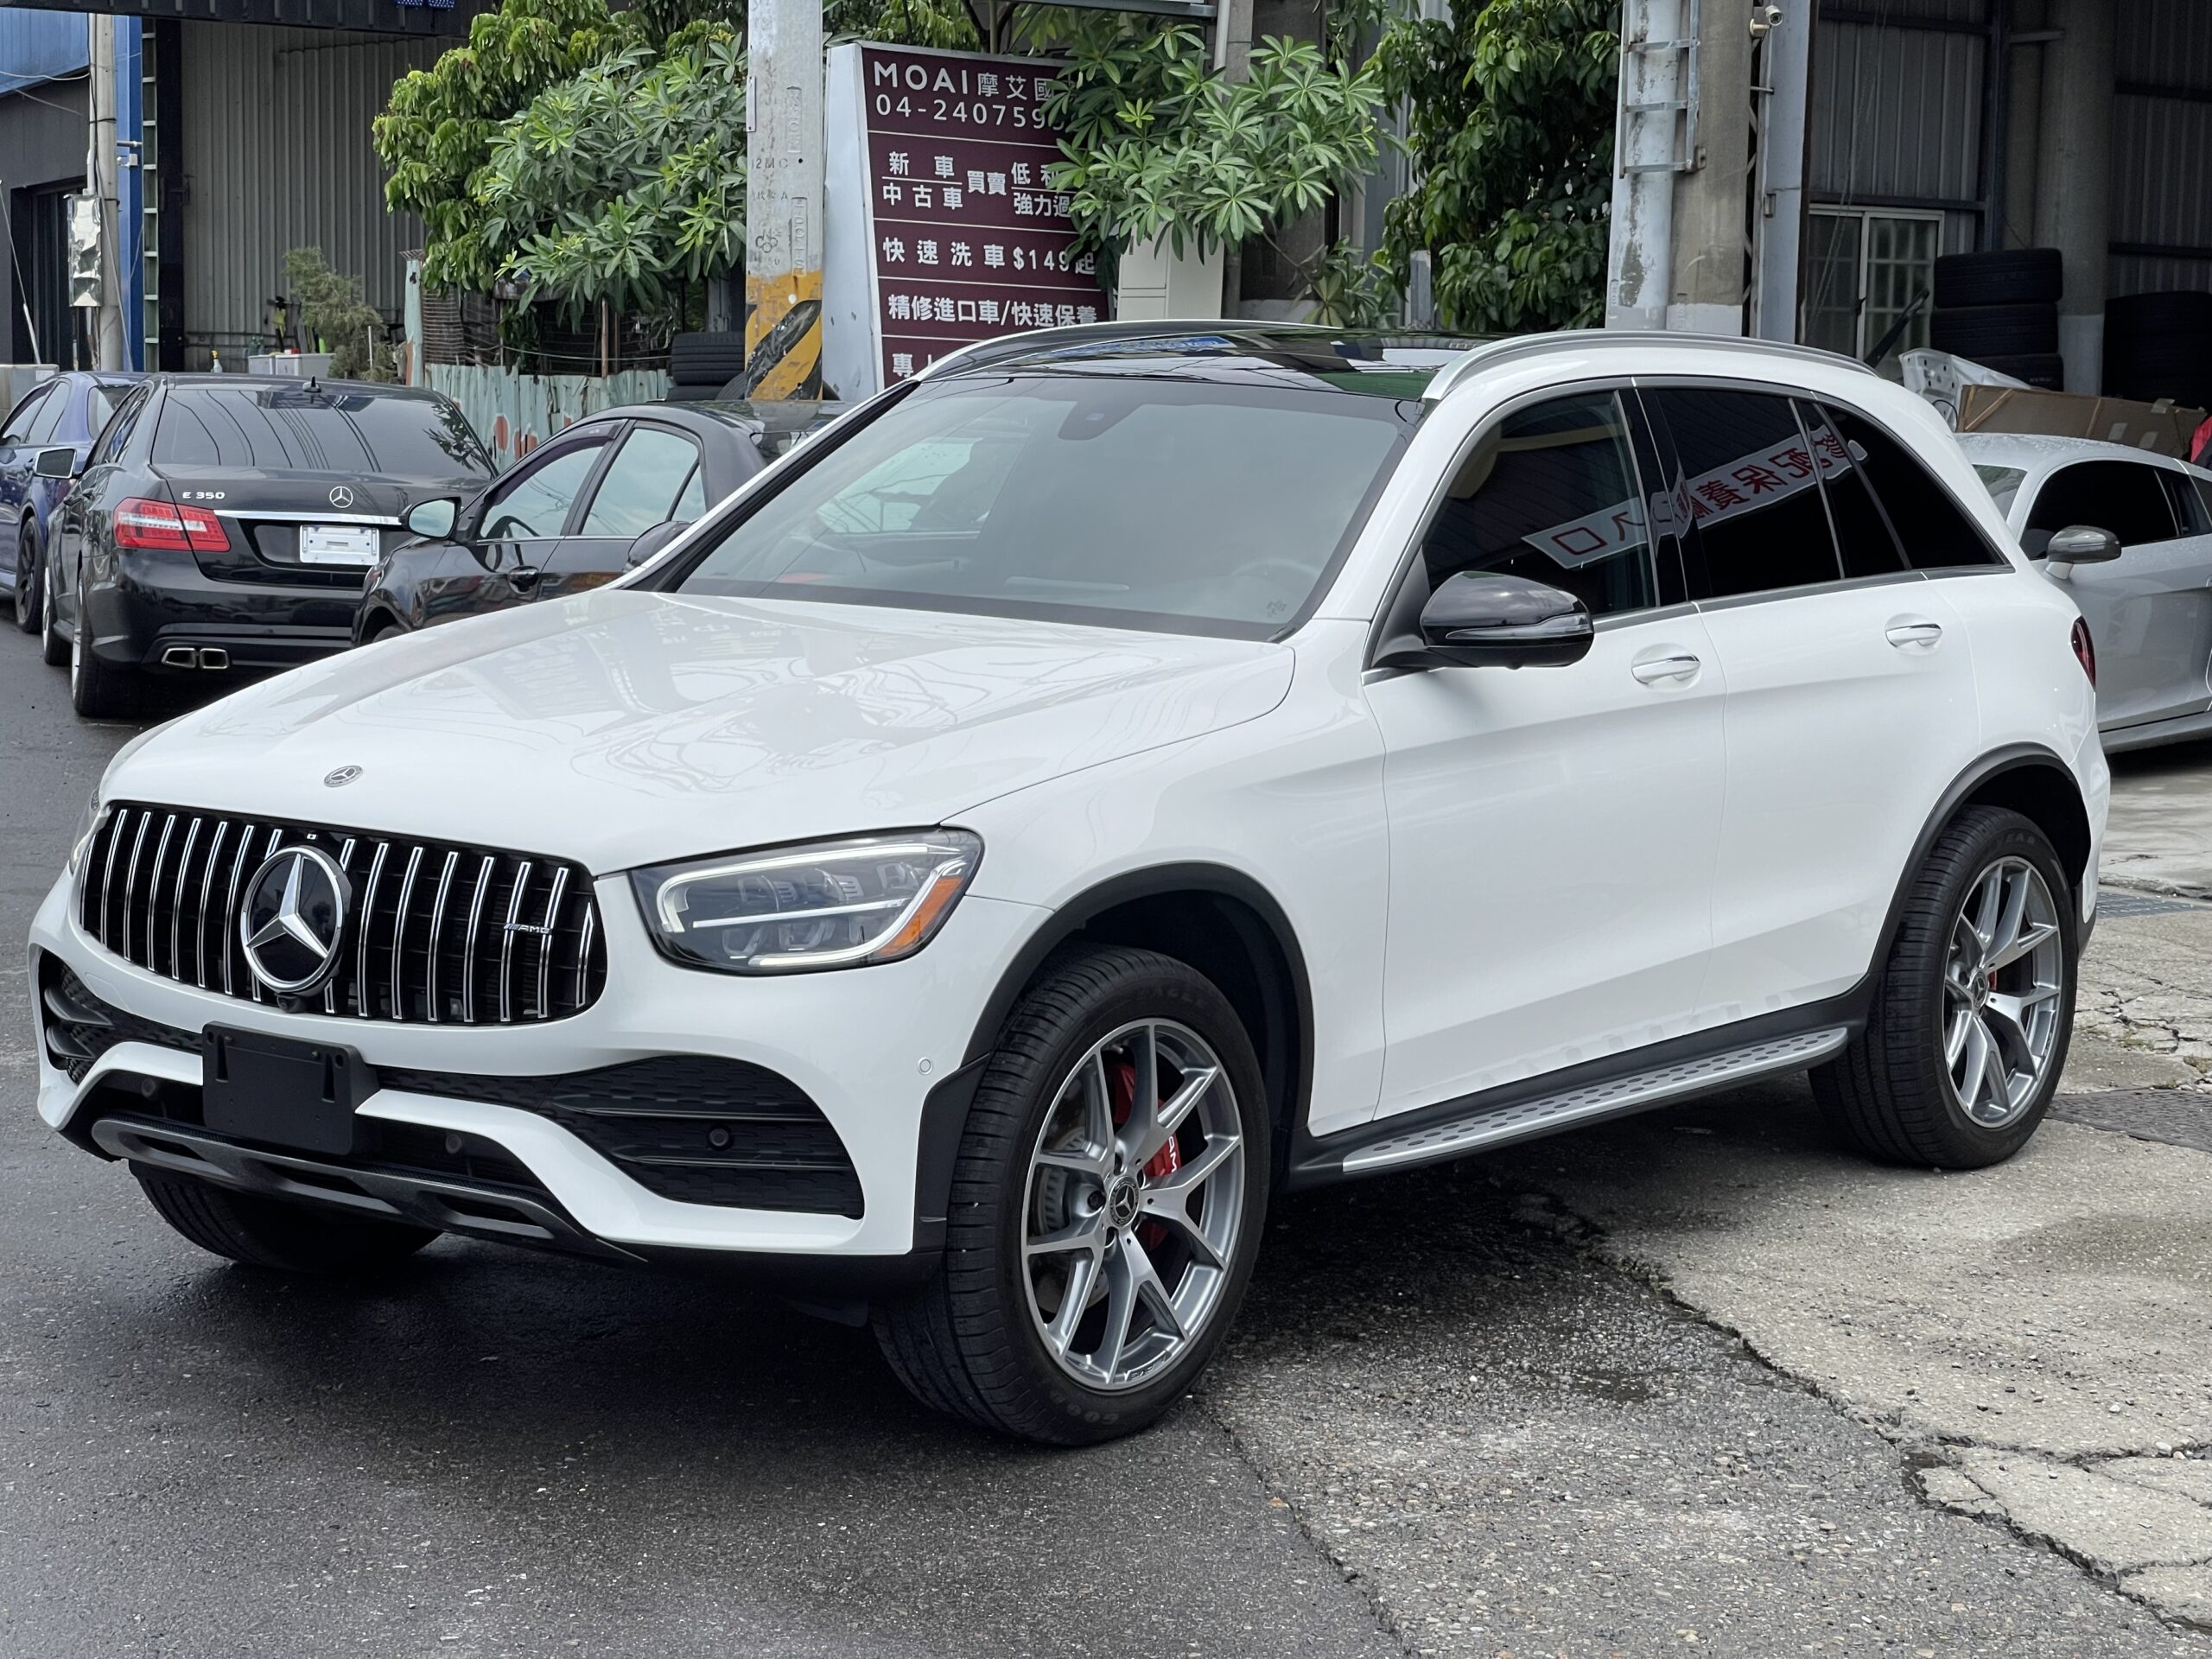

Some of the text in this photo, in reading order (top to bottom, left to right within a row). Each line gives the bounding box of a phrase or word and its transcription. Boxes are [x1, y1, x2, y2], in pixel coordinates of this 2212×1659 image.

[874, 60, 1070, 103] MOAI 摩艾國
[882, 181, 963, 210] 中古車
[967, 169, 1007, 196] 買賣
[182, 491, 226, 499] E 350
[517, 925, 551, 934] AMG
[1168, 1135, 1178, 1173] AM
